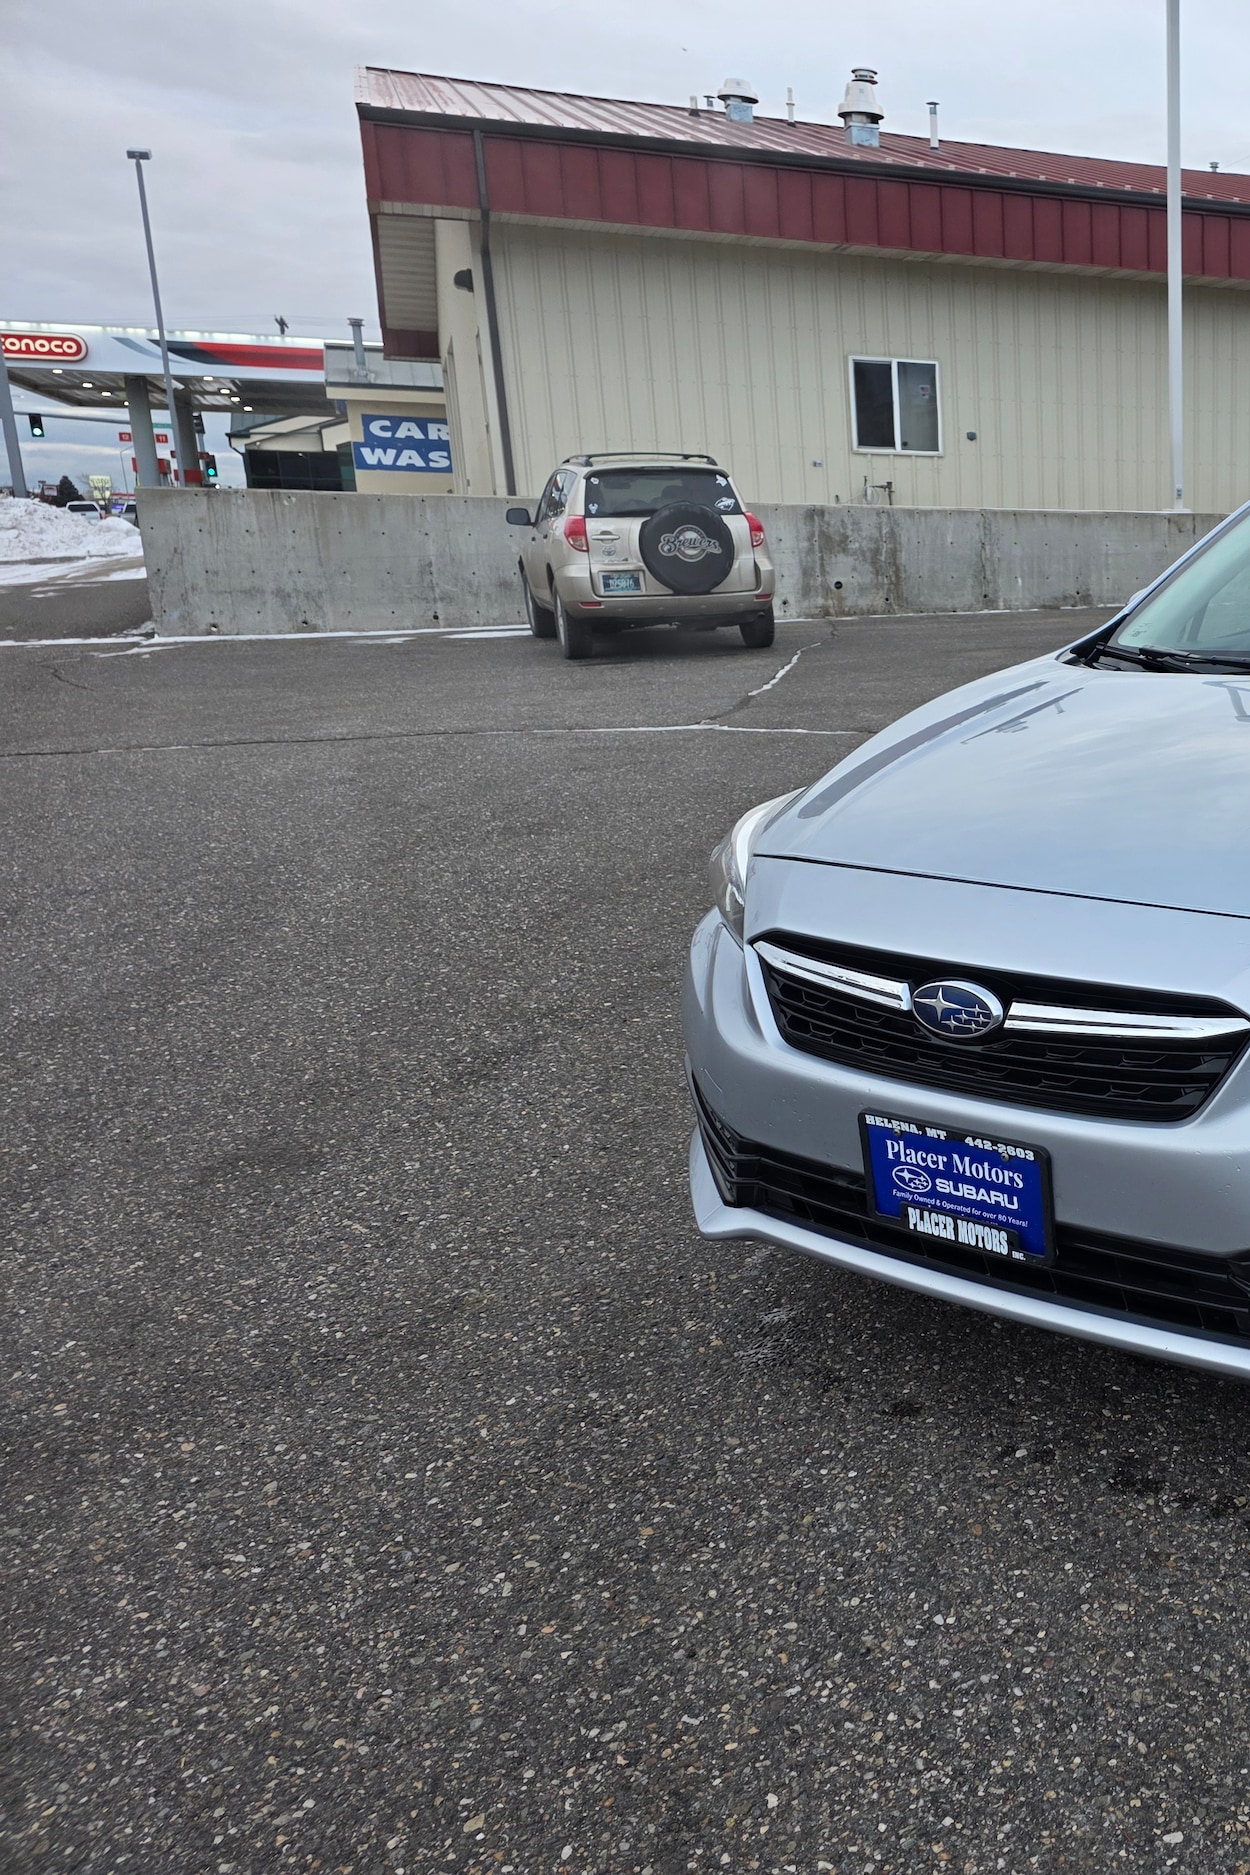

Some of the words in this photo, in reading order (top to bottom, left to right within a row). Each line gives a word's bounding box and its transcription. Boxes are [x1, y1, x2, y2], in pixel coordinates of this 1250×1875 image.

[369, 419, 450, 440] CAR
[661, 534, 721, 555] Brewers
[925, 1127, 947, 1140] MT
[965, 1136, 1035, 1161] 442-2603
[885, 1139, 947, 1171] Placer
[952, 1153, 1024, 1189] Motors
[892, 1189, 913, 1201] Family
[914, 1194, 936, 1205] Owned
[942, 1201, 971, 1213] Operated
[972, 1207, 981, 1216] for
[982, 1211, 997, 1219] over
[1008, 1216, 1028, 1228] Years!
[935, 1178, 1019, 1210] SUBARU
[908, 1206, 955, 1241] PLACER
[957, 1219, 1008, 1256] MOTORS
[1012, 1250, 1026, 1261] INC.
